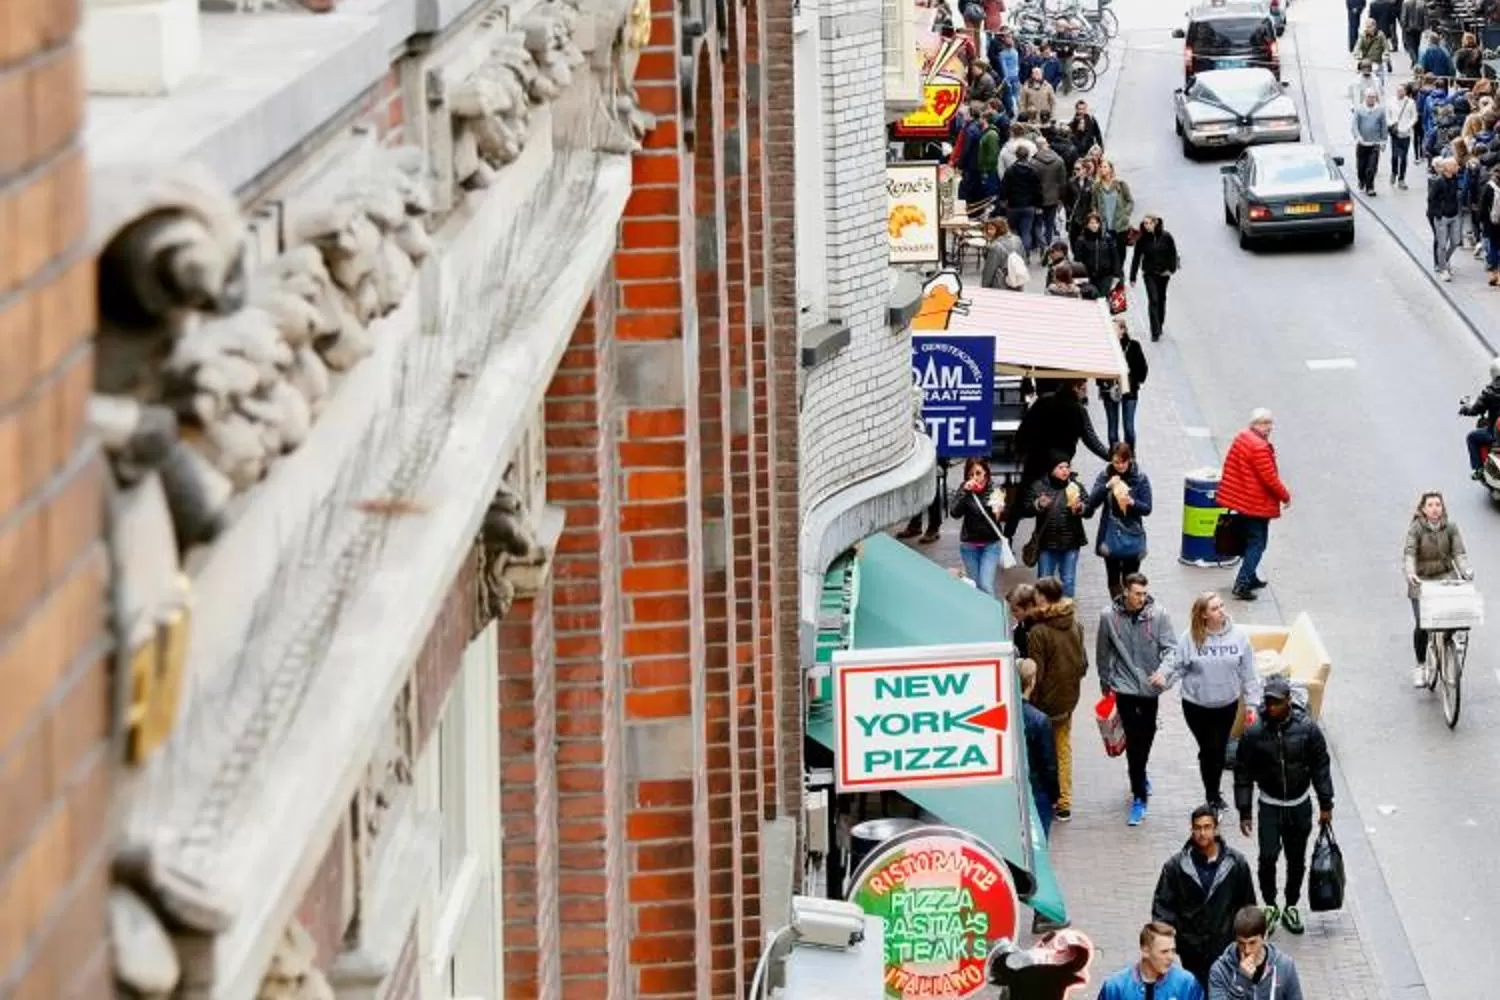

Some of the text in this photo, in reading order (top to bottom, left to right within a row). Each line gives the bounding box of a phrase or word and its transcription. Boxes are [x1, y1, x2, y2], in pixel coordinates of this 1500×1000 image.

[874, 673, 970, 700] NEW
[855, 705, 984, 737] YORK
[864, 744, 988, 772] PIZZA
[869, 849, 998, 894] RISTORANTE
[891, 888, 973, 914] PIZZA
